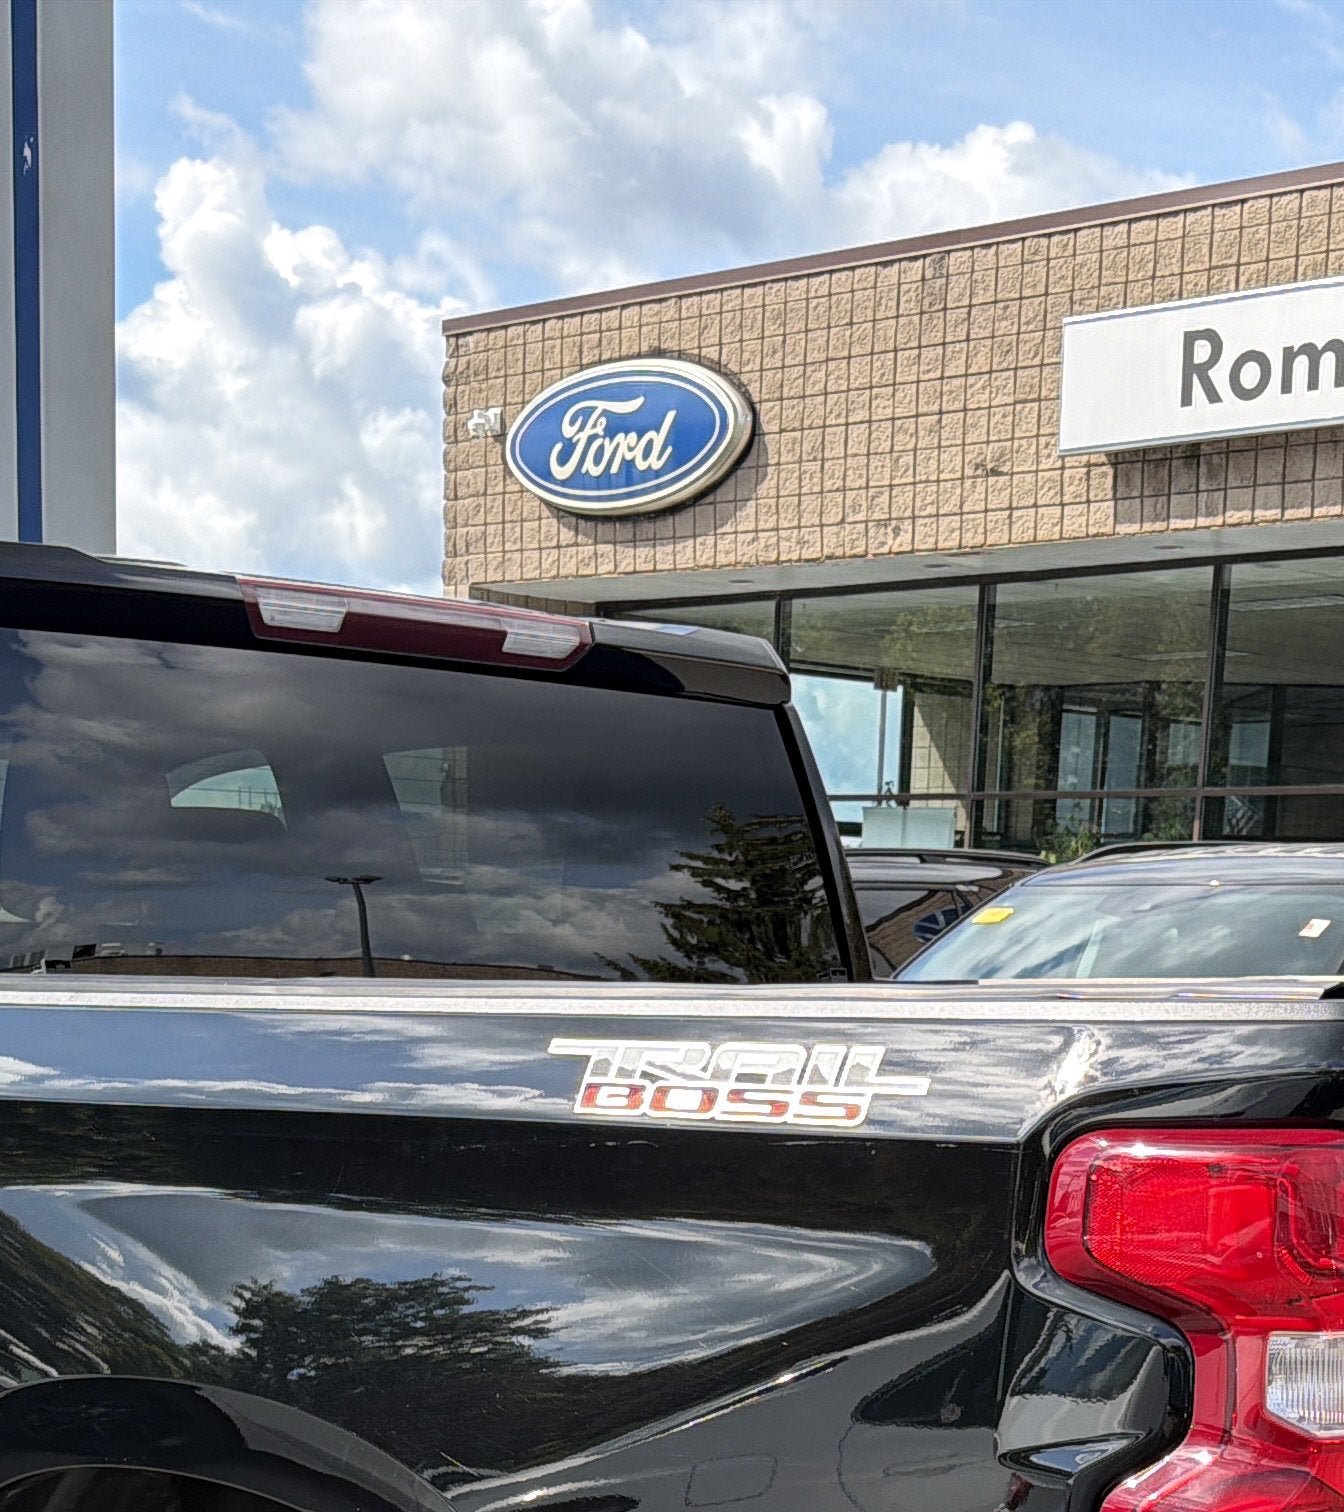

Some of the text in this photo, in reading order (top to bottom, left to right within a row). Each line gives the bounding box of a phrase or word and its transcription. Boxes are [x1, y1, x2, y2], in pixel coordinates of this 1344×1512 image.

[548, 395, 677, 481] Ford
[548, 1038, 931, 1095] TRAIL
[574, 1079, 873, 1127] BOSS
